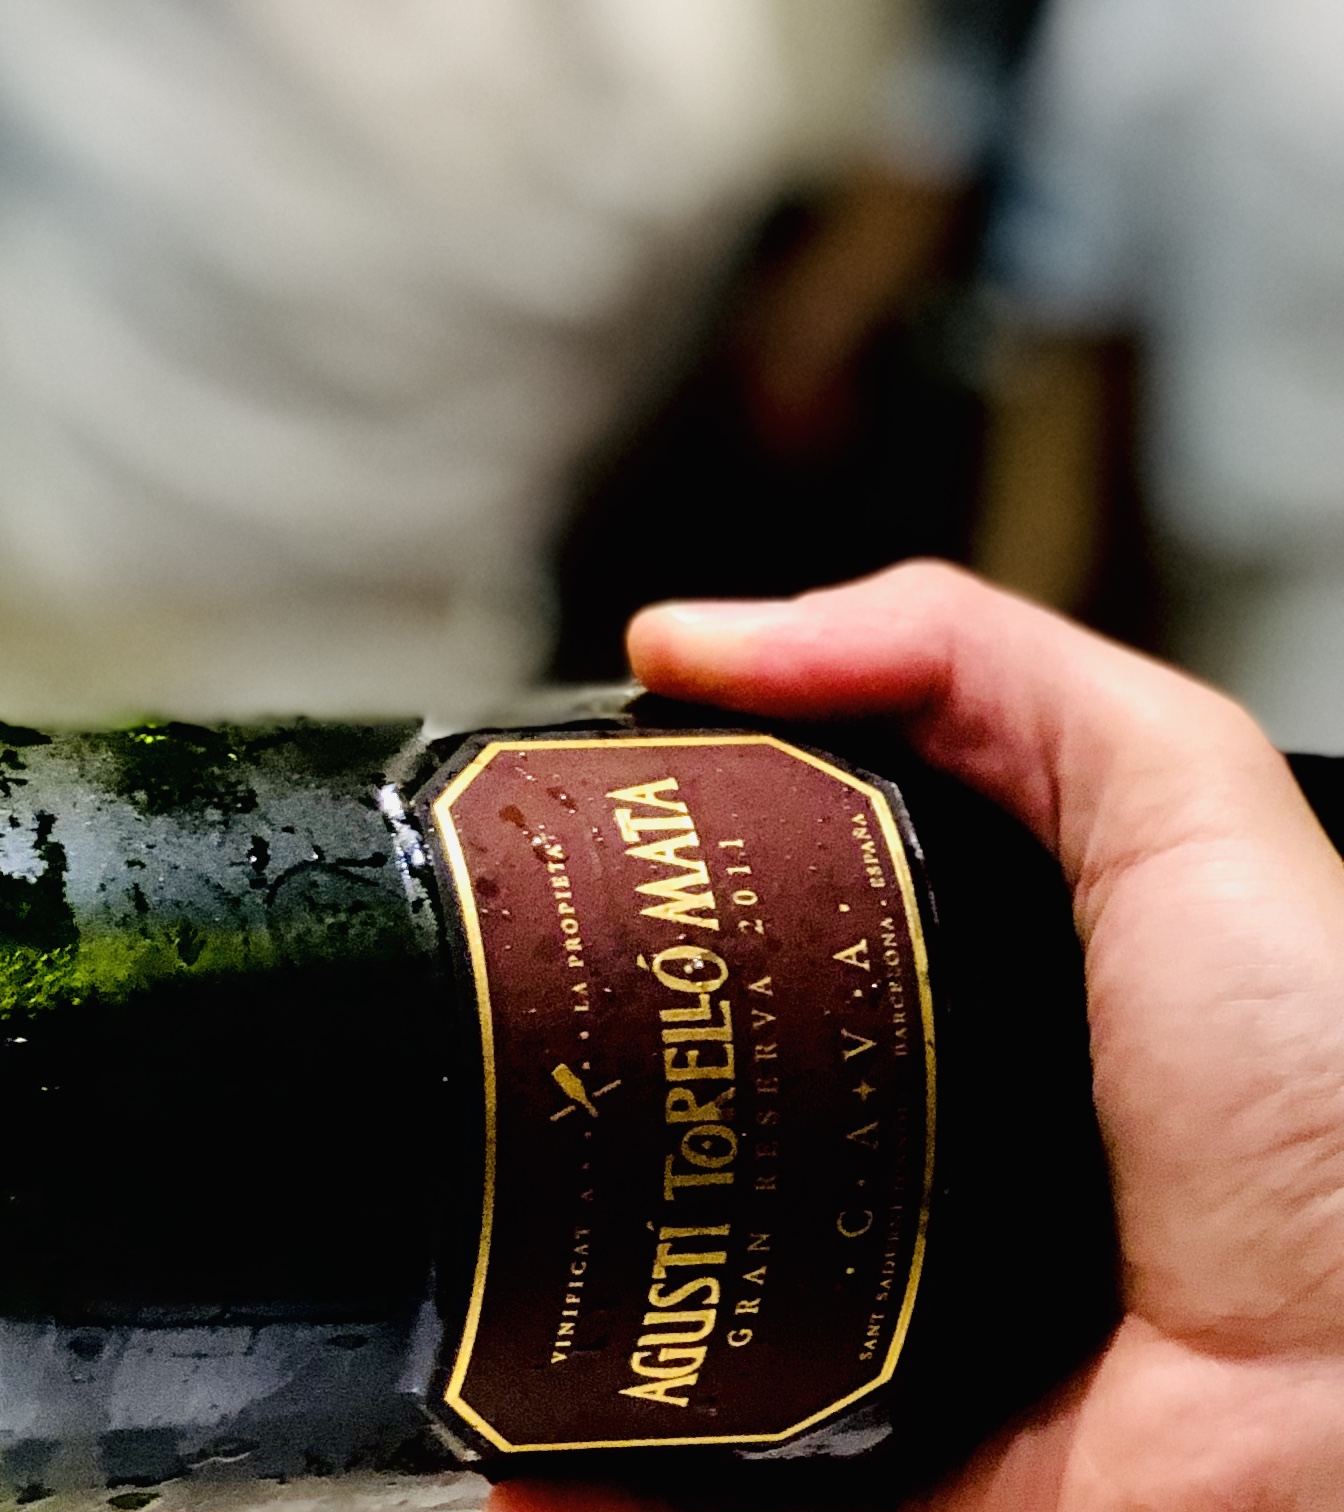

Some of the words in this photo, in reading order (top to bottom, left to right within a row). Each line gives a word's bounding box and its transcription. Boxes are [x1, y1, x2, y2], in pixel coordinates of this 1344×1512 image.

[606, 778, 721, 932] MATA
[718, 837, 765, 935] 2011
[850, 813, 886, 888] ESPAÑA
[746, 973, 781, 1191] RESERVA
[550, 1225, 591, 1364] VINIFICAT
[571, 982, 590, 1012] LA
[618, 1220, 731, 1408] AGUSTÍ
[726, 1231, 771, 1347] GRAN
[858, 1312, 887, 1360] SANT
